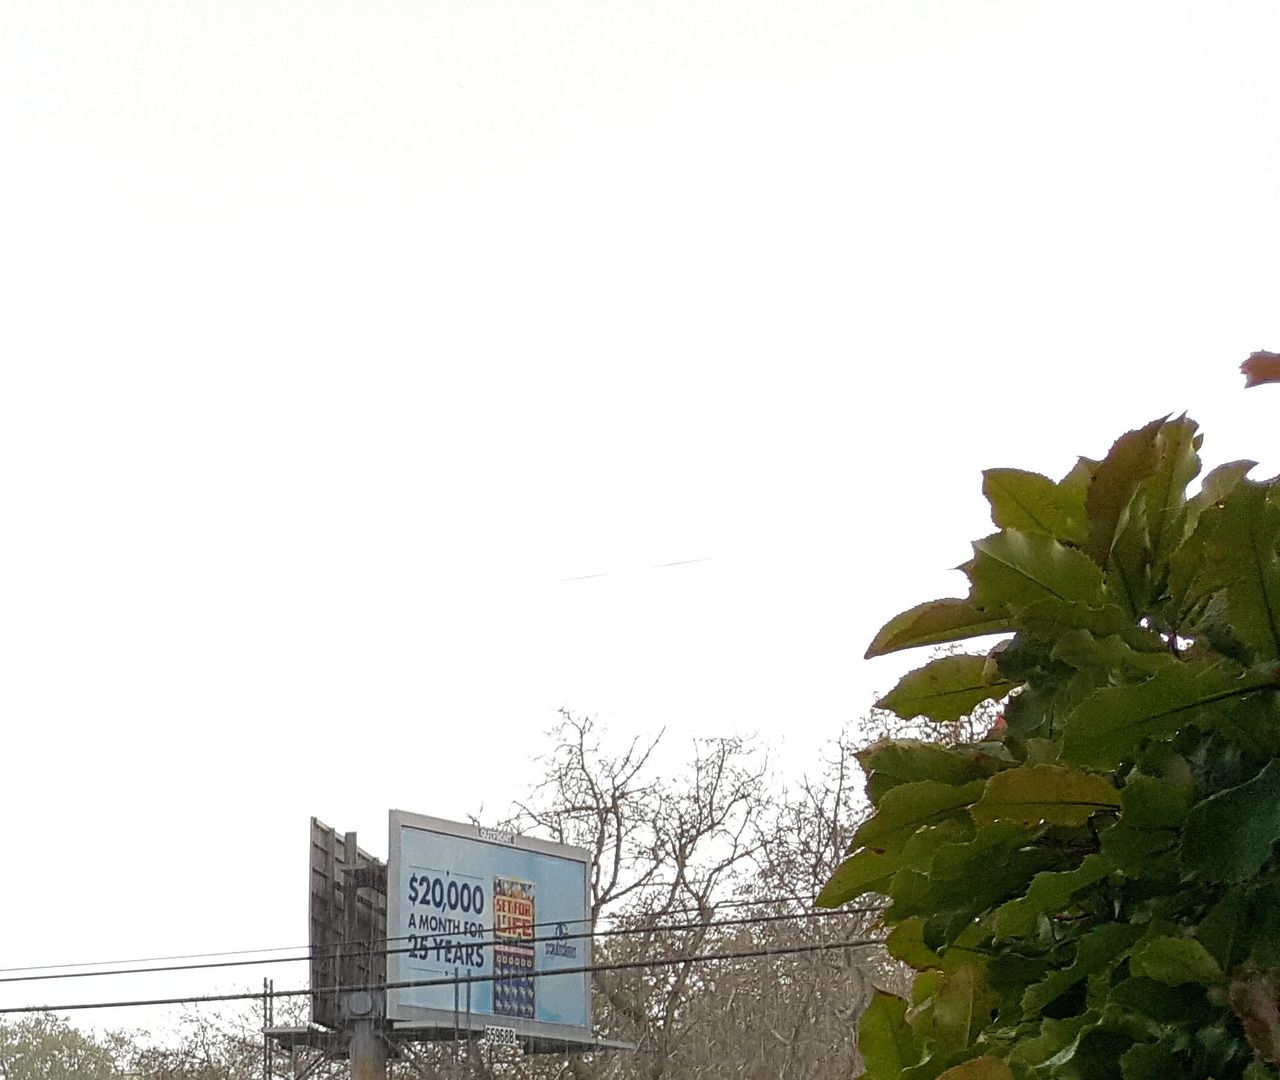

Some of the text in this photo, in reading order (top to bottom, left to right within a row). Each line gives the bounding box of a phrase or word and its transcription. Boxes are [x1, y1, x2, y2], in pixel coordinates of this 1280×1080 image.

[408, 872, 484, 914] $20,000
[496, 899, 531, 917] SET FOR
[408, 913, 484, 939] A MONTH FOR
[496, 915, 531, 938] LIFE
[408, 934, 484, 968] 25 YEARS
